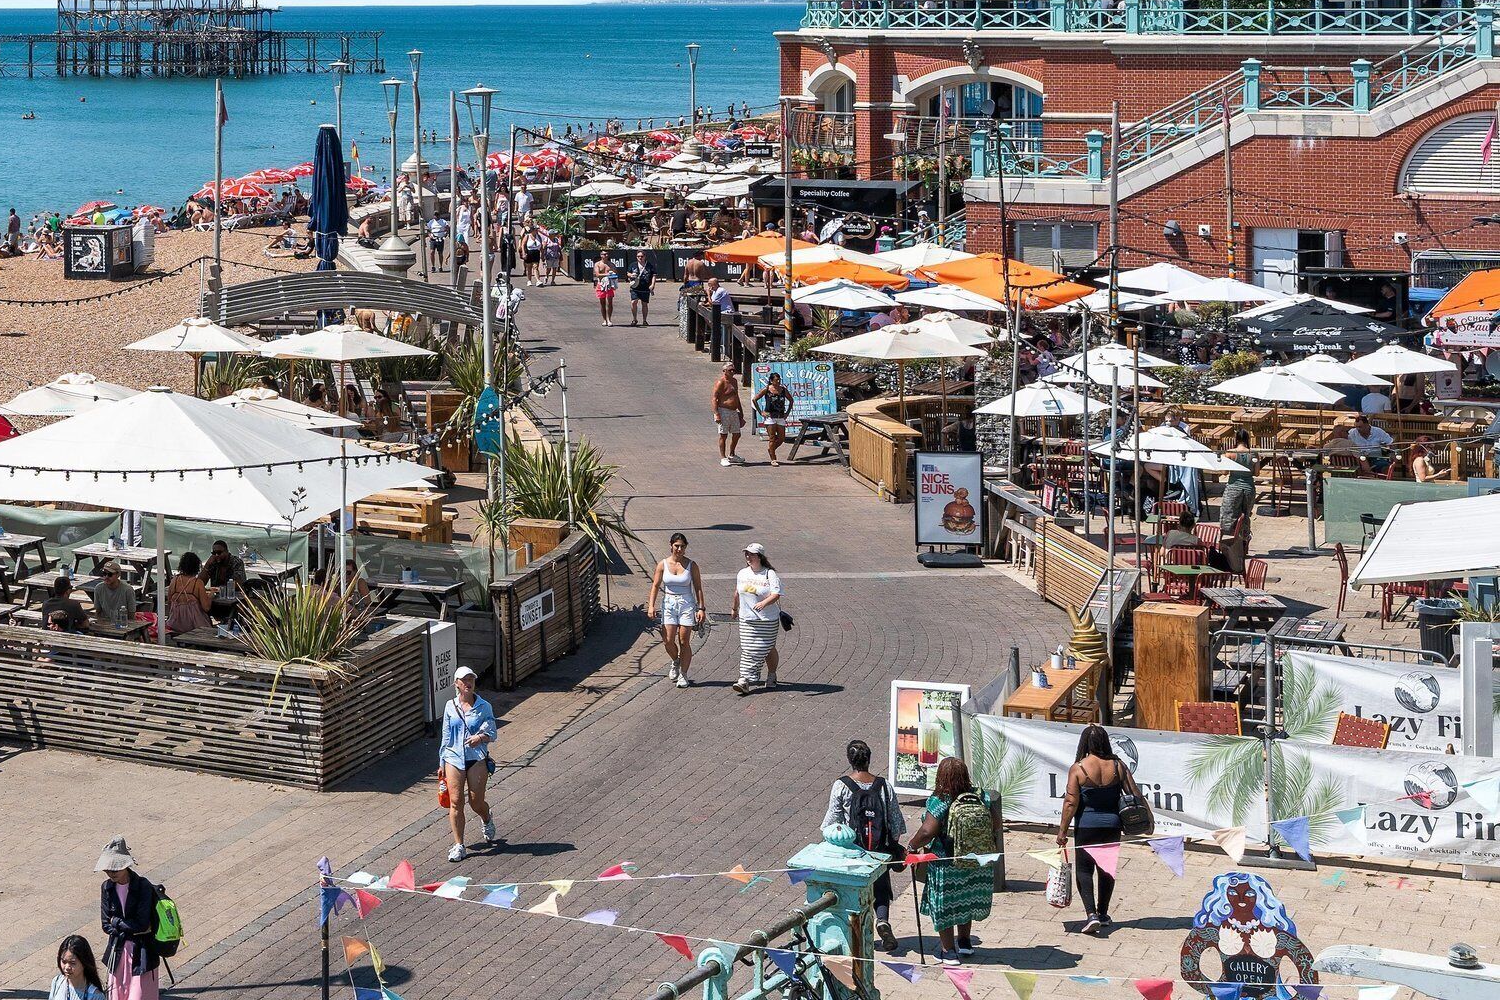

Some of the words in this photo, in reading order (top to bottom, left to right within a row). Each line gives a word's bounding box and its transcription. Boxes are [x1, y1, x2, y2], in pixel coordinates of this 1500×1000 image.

[800, 190, 830, 198] Speciality
[727, 264, 742, 274] Hall
[786, 369, 795, 378] &
[792, 382, 812, 390] THE
[921, 473, 950, 484] NICE
[921, 484, 955, 495] BUNS
[522, 606, 541, 627] SUNSET
[435, 650, 451, 666] PLEASE
[437, 664, 449, 678] TAKE
[435, 681, 439, 692] A
[440, 676, 451, 691] SEAT
[1437, 714, 1461, 739] Fi
[1415, 744, 1442, 752] Cocktails
[1135, 782, 1184, 813] Fin
[1455, 811, 1500, 841] Fin
[1395, 844, 1419, 852] Brunch
[1429, 847, 1461, 855] Cocktails
[1230, 961, 1269, 975] GALLERY
[1235, 973, 1263, 984] OPEN
